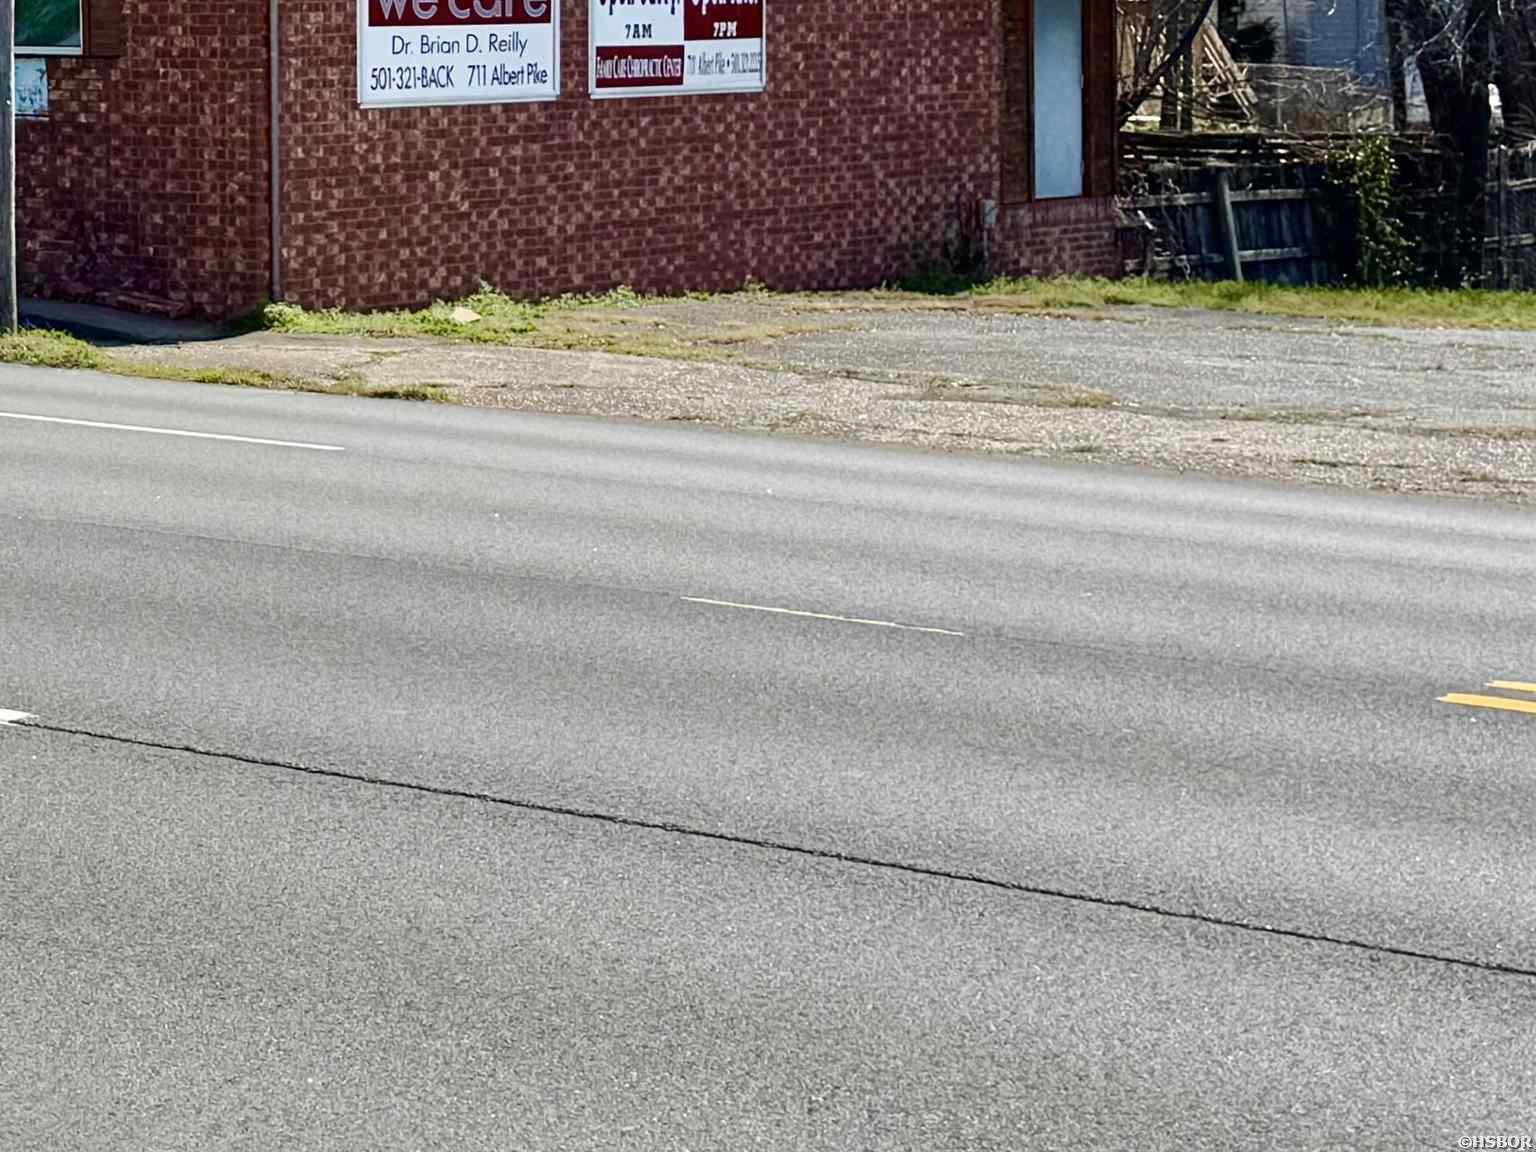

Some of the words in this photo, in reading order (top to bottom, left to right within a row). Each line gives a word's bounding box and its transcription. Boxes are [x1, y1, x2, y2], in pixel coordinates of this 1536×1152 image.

[625, 24, 652, 39] 7AM
[713, 22, 738, 38] 7PM
[391, 35, 414, 55] Dr.
[420, 35, 460, 54] Brian
[466, 33, 483, 53] D.
[488, 31, 529, 58] Reilly
[370, 65, 454, 90] 501-321-BACK
[467, 64, 487, 87] 711
[491, 63, 524, 86] Albert
[527, 61, 548, 85] Pike
